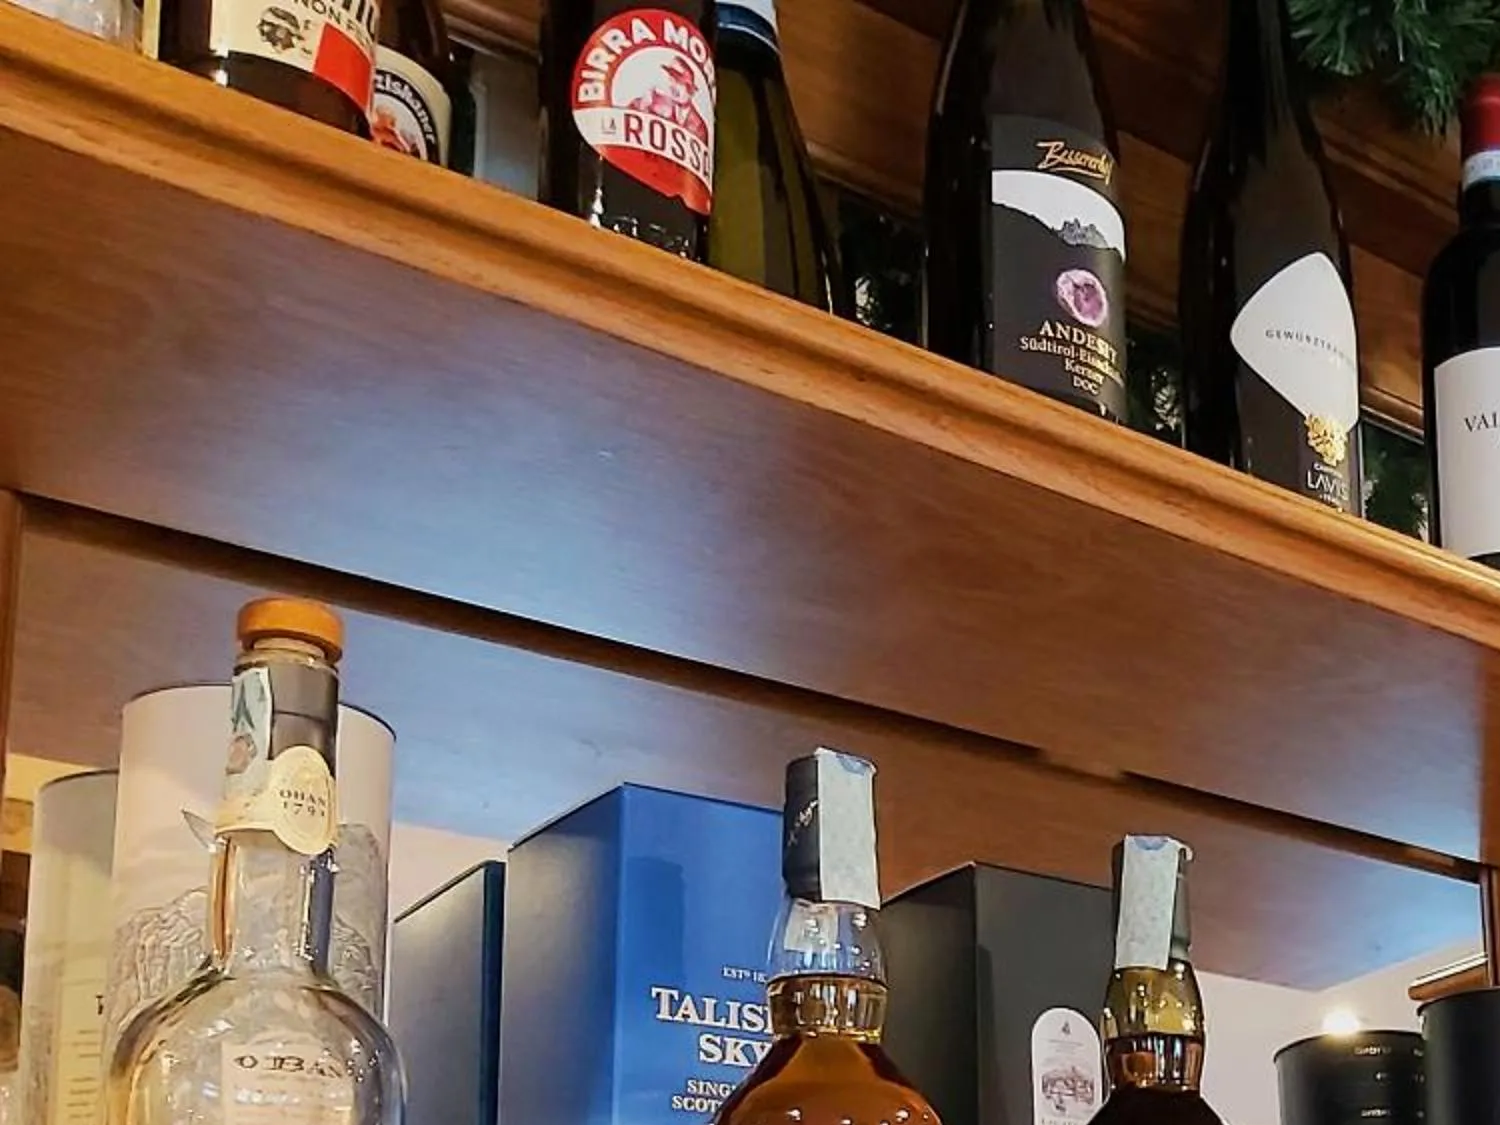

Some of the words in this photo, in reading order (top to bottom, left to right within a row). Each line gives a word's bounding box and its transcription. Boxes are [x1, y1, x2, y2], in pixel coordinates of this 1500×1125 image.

[578, 17, 657, 103] BIRRA
[1072, 375, 1101, 395] DOC
[233, 1054, 344, 1079] OBAN
[686, 1079, 737, 1098] SING
[671, 1095, 723, 1114] SCOT
